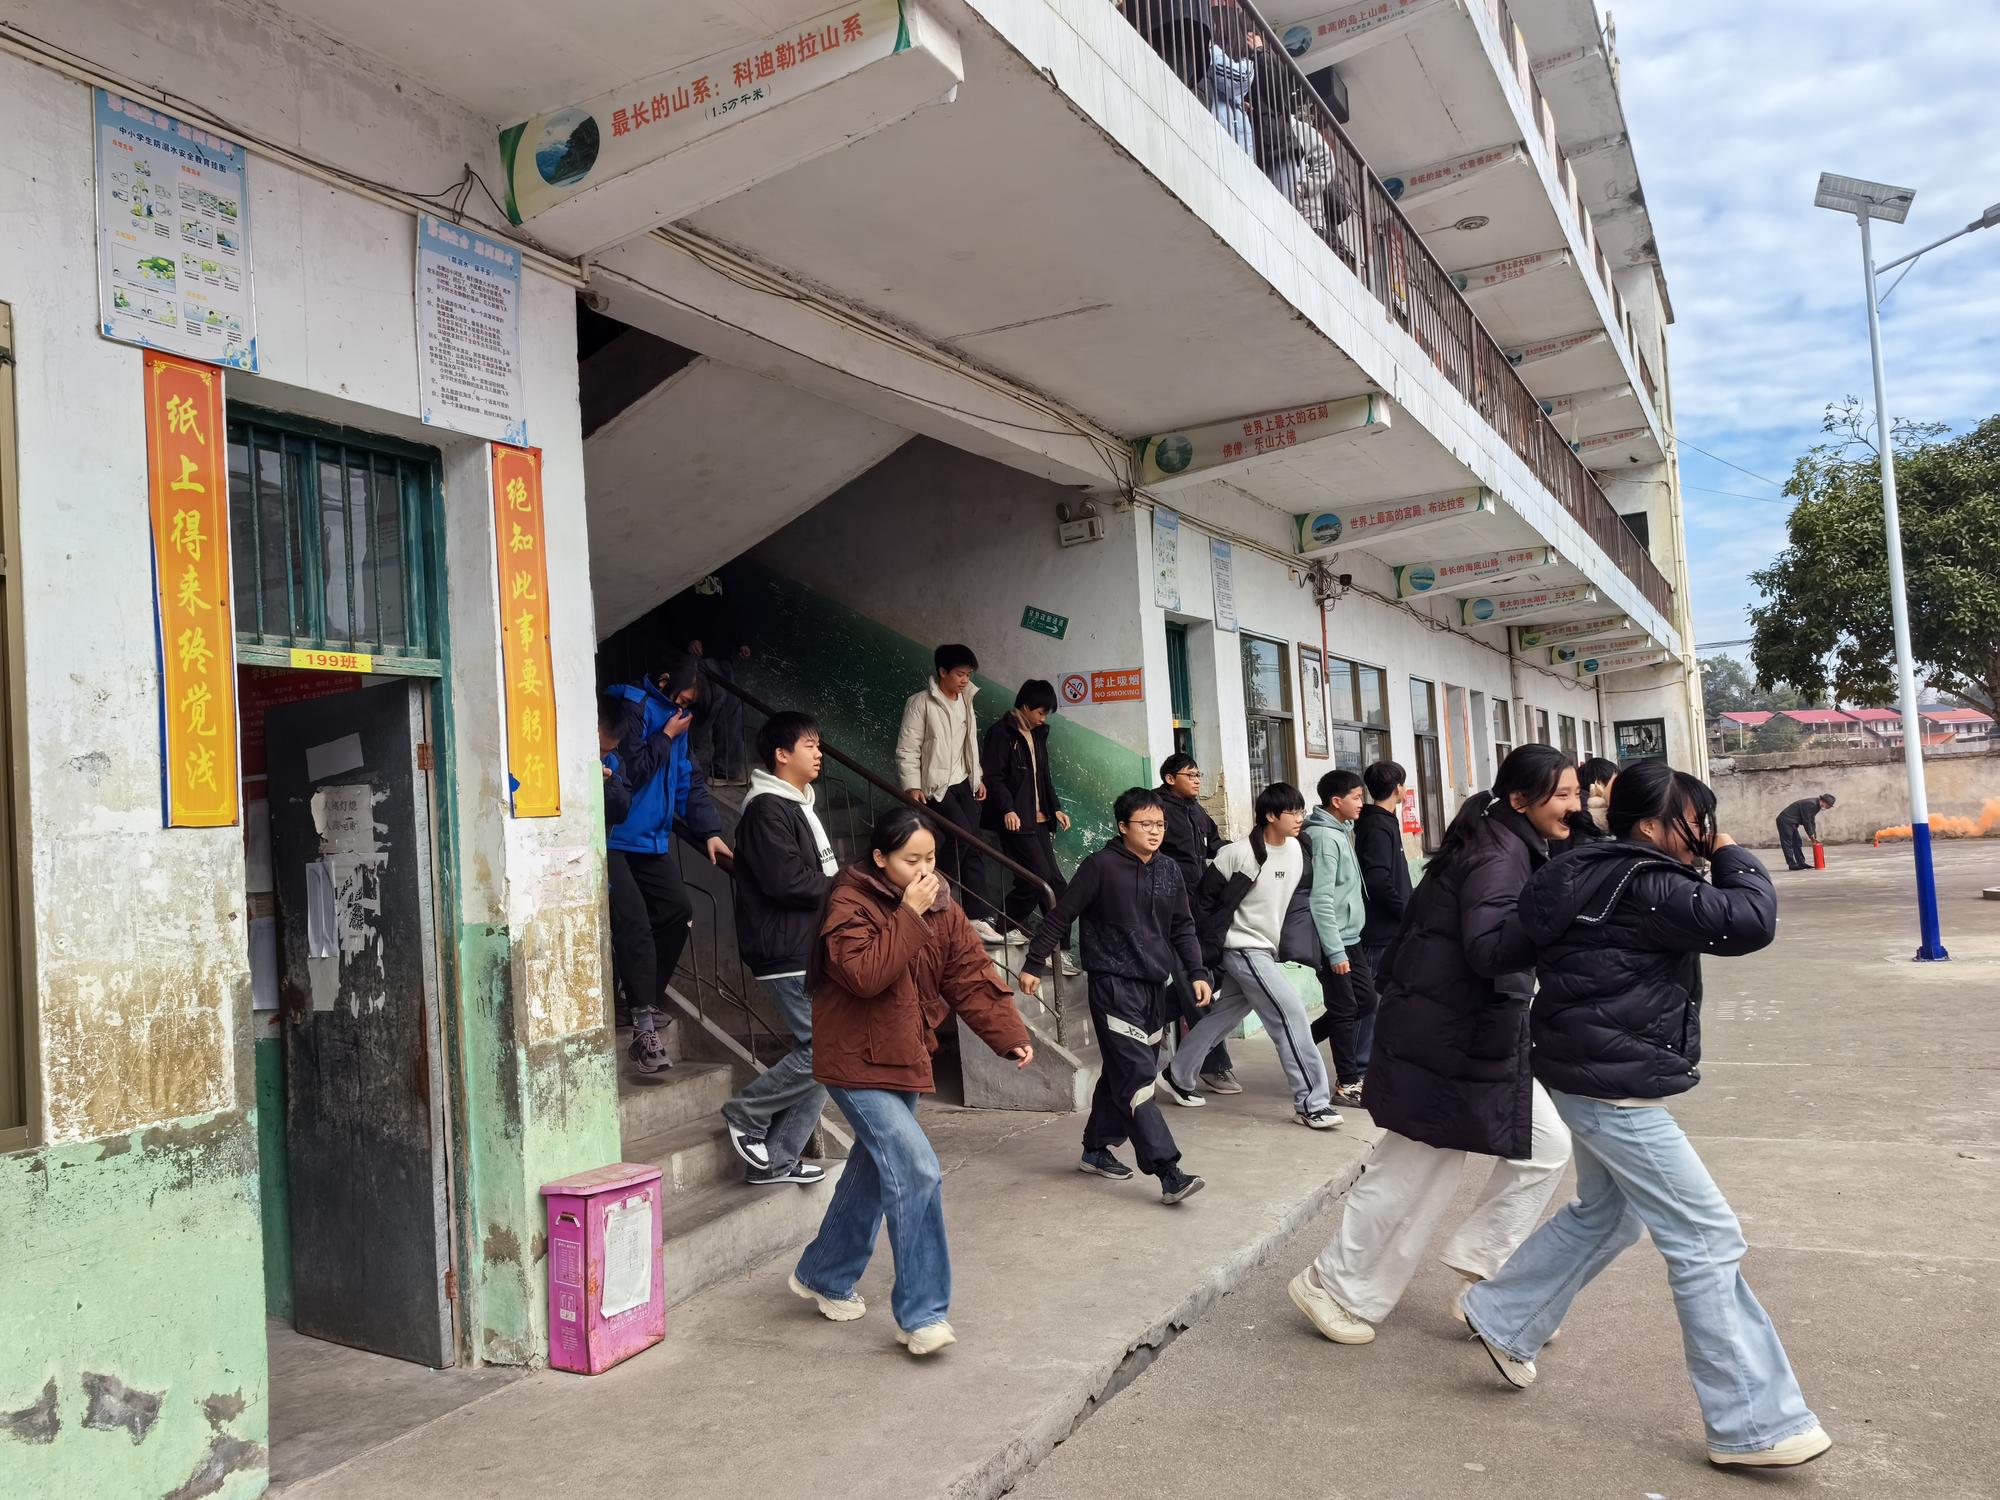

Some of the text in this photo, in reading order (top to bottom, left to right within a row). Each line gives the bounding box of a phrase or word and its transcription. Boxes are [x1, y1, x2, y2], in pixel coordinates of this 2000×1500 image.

[610, 12, 865, 137] 最长的山系：科迪勒拉山系
[119, 126, 227, 174] 中小学生防溺水安全教育挂图
[1243, 404, 1329, 437] 世界上最大的石刻
[1222, 429, 1297, 458] 佛像：乐山大佛
[1350, 496, 1465, 529] 世界上最高的宫殿：布达拉宫
[166, 394, 217, 793] 纸上得来终觉浅
[506, 476, 545, 789] 绝知此事要躬行
[306, 653, 358, 670] 199班
[1094, 674, 1140, 689] 禁止吸烟
[1106, 689, 1140, 697] SMOKING
